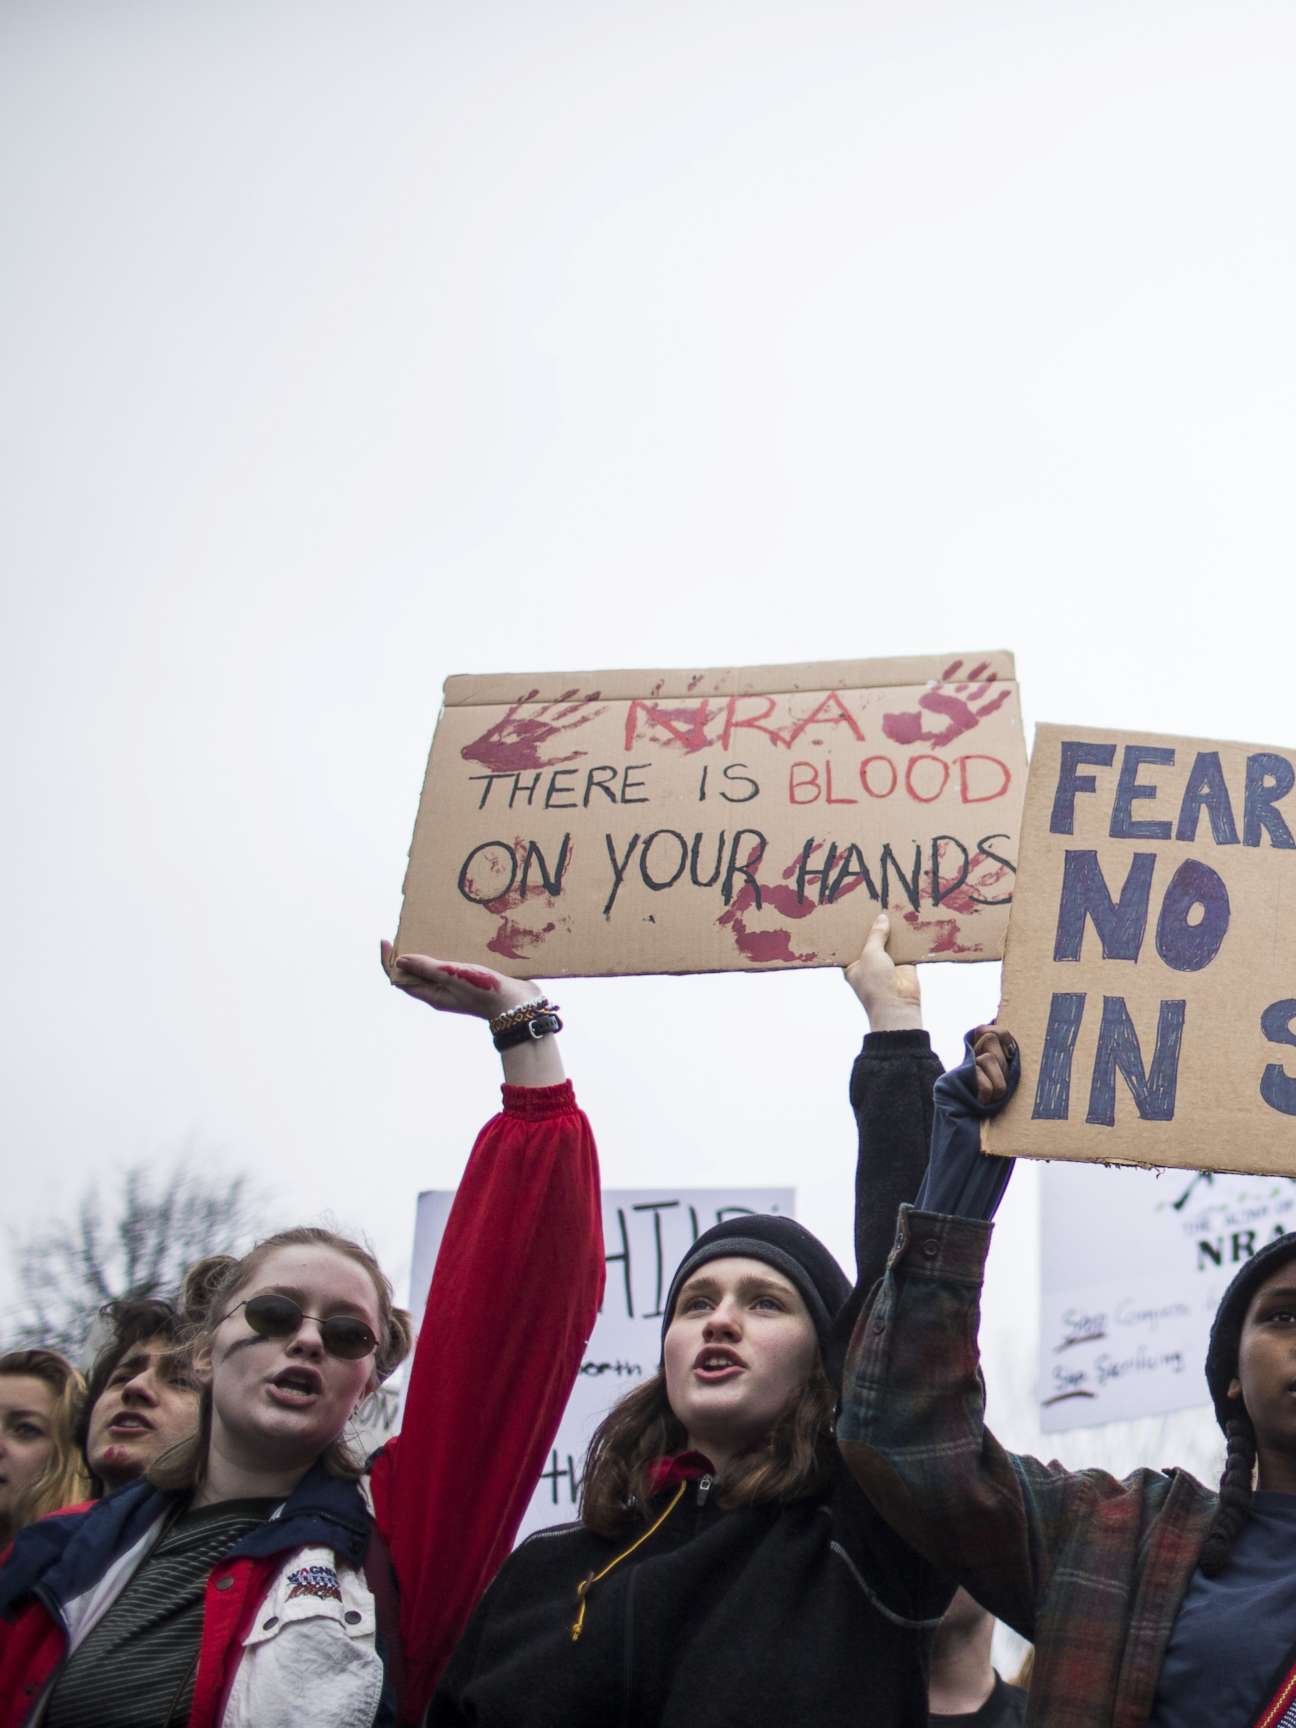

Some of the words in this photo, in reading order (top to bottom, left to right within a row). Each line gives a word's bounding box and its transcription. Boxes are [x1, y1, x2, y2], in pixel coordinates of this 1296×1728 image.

[624, 690, 866, 752] NRA
[469, 762, 652, 810] THERE
[699, 763, 761, 804] IS
[788, 754, 1012, 806] BLOOD
[457, 832, 572, 905] ON
[604, 829, 767, 914] YOUR
[795, 833, 1017, 913] HANDS
[1053, 849, 1231, 973] NO
[1031, 992, 1187, 1127] IN
[1198, 1223, 1286, 1273] NR
